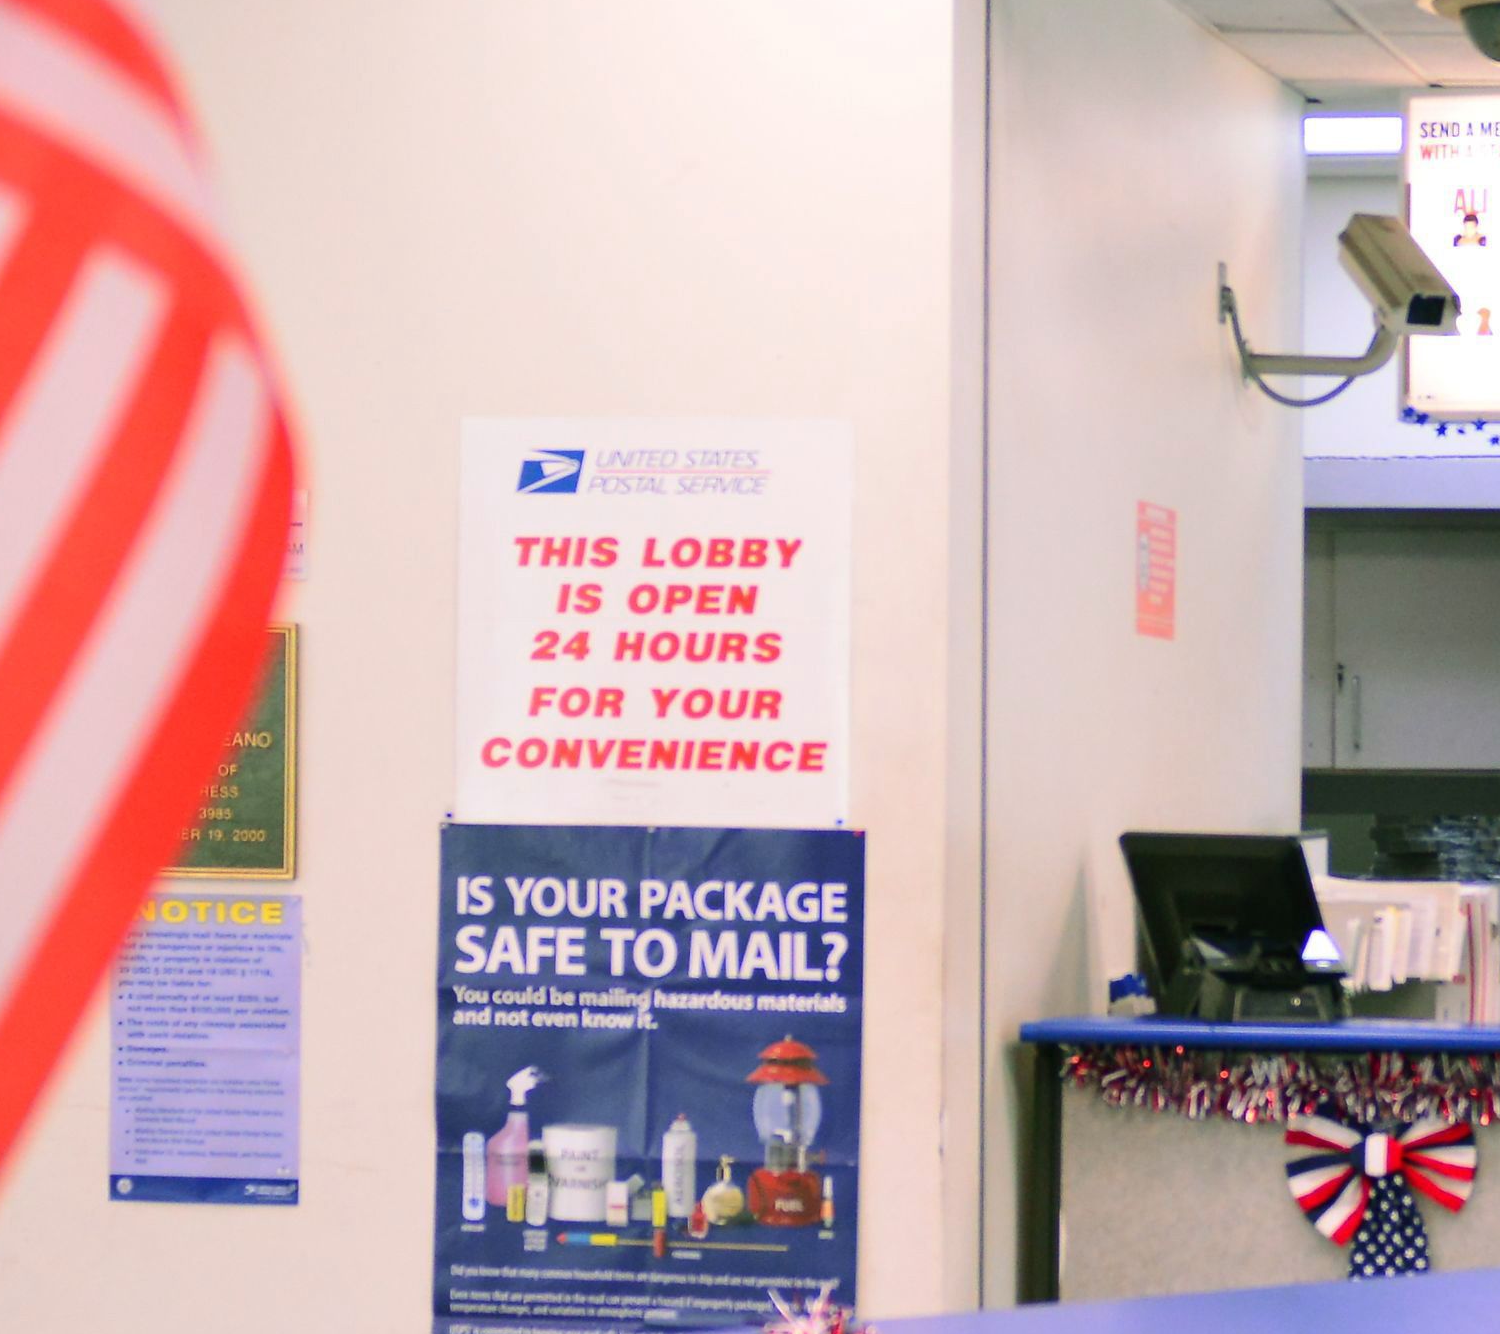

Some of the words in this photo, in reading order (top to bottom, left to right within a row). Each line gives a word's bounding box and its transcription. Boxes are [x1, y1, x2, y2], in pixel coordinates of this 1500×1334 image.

[1420, 122, 1460, 138] SEND
[1467, 122, 1474, 136] A
[1420, 144, 1459, 160] WITH
[595, 449, 678, 469] UNITED
[686, 450, 761, 469] STATES
[588, 476, 668, 495] POSTAL
[677, 477, 767, 495] SERVICE
[514, 536, 619, 567] THIS
[642, 537, 803, 569] LOBBY
[556, 584, 603, 614] IS
[627, 584, 759, 615] OPEN
[530, 630, 591, 661] 24
[614, 631, 783, 664] HOURS
[528, 686, 625, 718] FOR
[651, 688, 783, 721] YOUR
[480, 737, 828, 772] CONVENIENCE
[218, 764, 238, 777] OF
[233, 829, 267, 842] 2000
[456, 876, 494, 915] IS
[505, 877, 628, 919] YOUR
[638, 880, 849, 923] PACKAGE
[135, 899, 283, 925] NOTICE
[454, 926, 587, 977] SAFE
[600, 928, 678, 978] TO
[687, 932, 849, 983] MAIL?
[453, 985, 489, 1004] You
[492, 986, 546, 1006] could
[550, 986, 575, 1006] be
[579, 987, 651, 1011] mailing
[654, 989, 753, 1011] hazardous
[756, 992, 847, 1013] materials
[453, 1008, 490, 1026] and
[494, 1009, 529, 1027] not
[532, 1012, 578, 1028] even
[581, 1010, 634, 1029] know
[637, 1011, 659, 1031] it.
[561, 1148, 600, 1163] PAINT
[775, 1199, 805, 1213] FUEL
